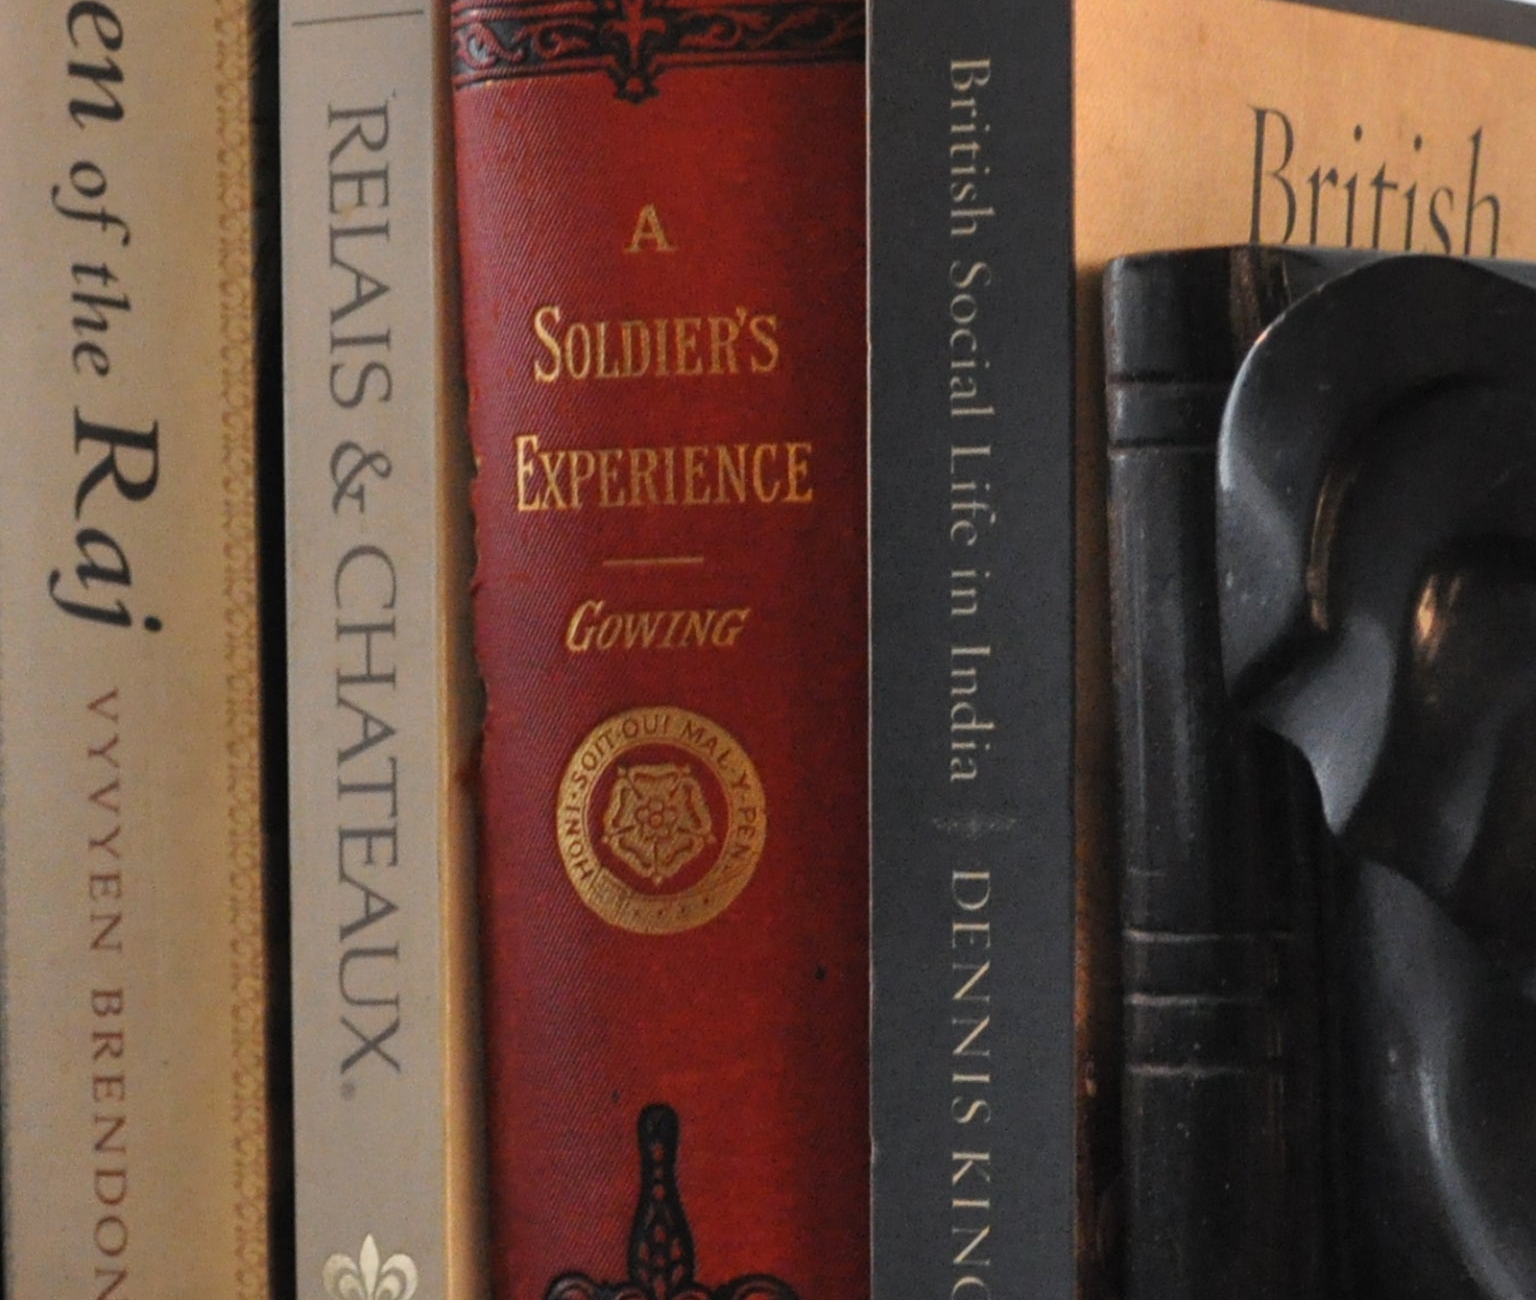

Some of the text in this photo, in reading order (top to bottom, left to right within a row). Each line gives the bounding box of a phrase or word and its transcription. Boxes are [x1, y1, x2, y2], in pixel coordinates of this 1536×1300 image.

[53, 159, 129, 247] of
[625, 203, 674, 254] A
[1247, 104, 1501, 257] British
[328, 102, 392, 410] RELAIS
[70, 262, 131, 378] the
[534, 306, 780, 383] SOLDIER'S
[515, 435, 815, 512] EXPERIENCE
[949, 55, 995, 784] British Social Life in India
[49, 406, 163, 635] Raj
[329, 441, 392, 515] &
[566, 599, 752, 652] GOWING
[85, 686, 124, 955] VYVYEN
[950, 868, 993, 1125] DENNIS
